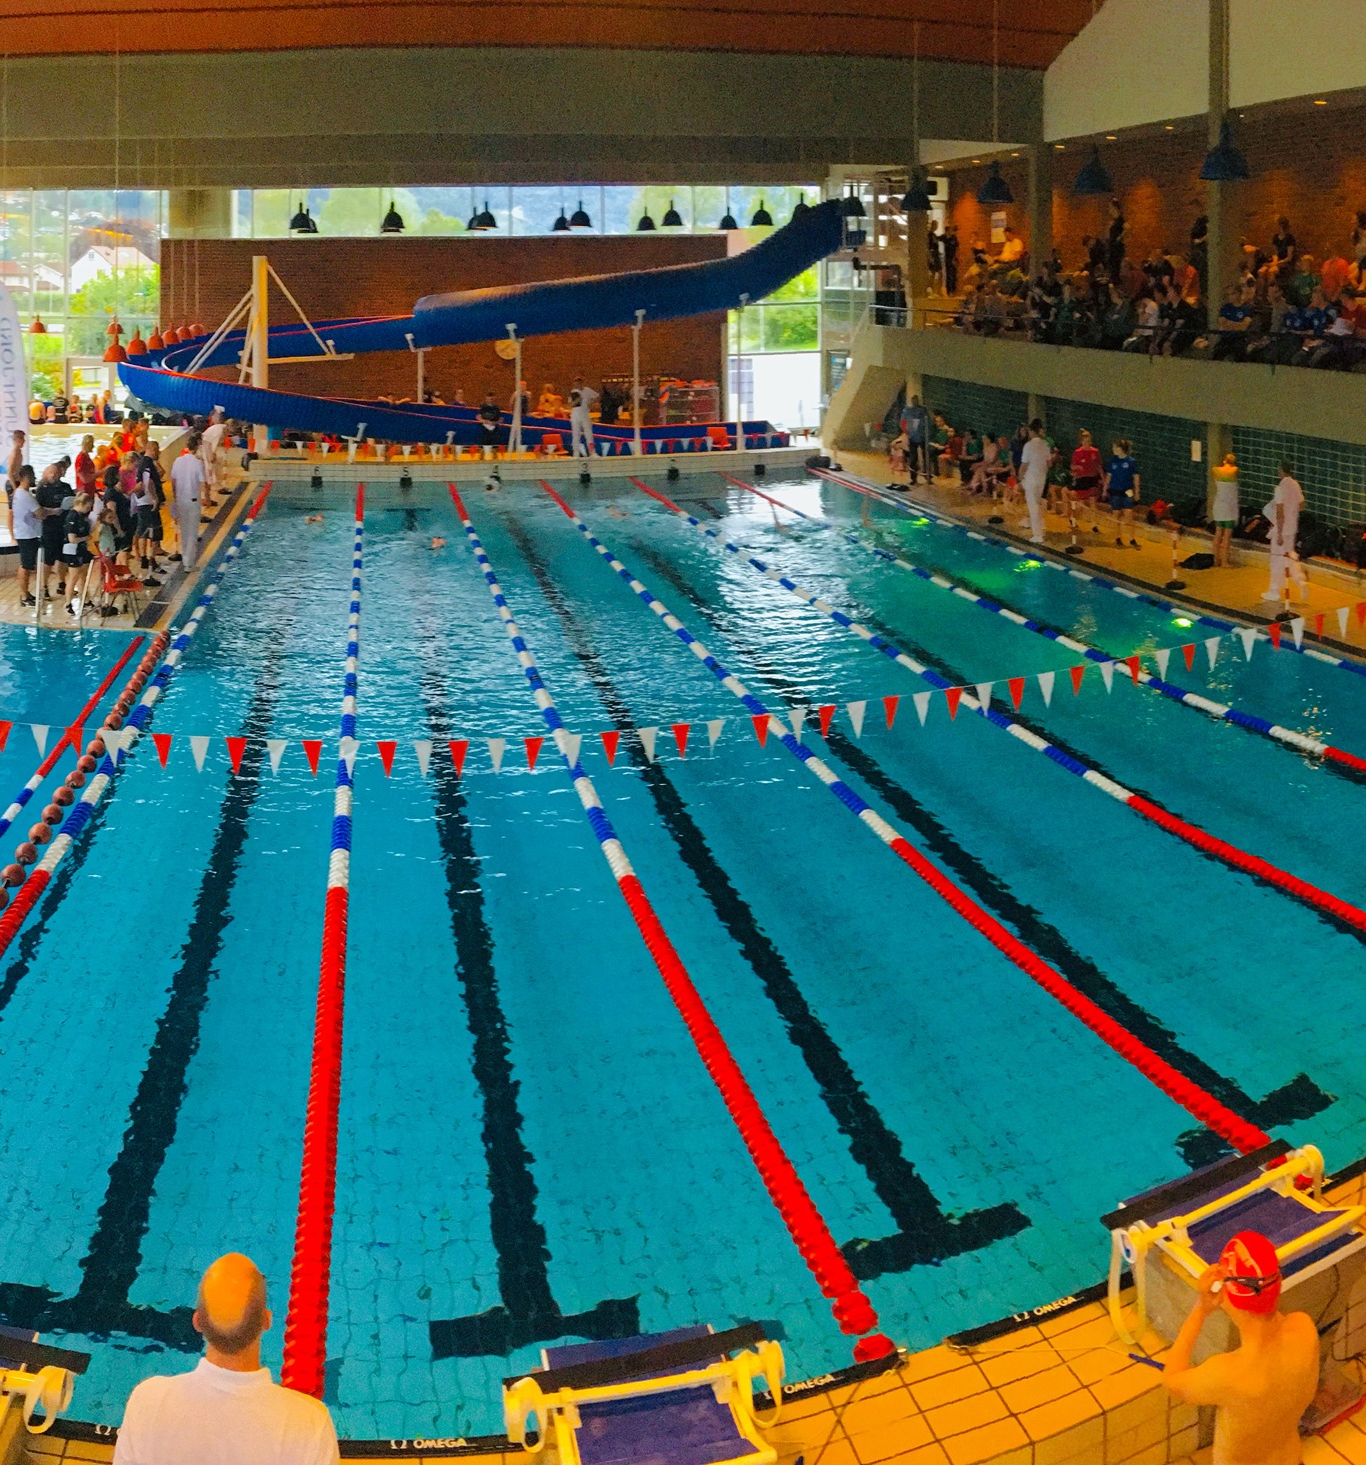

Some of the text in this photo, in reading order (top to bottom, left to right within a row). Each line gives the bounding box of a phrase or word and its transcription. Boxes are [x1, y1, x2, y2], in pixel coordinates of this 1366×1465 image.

[1033, 1295, 1077, 1316] OMEGA
[783, 1373, 835, 1394] OMEGA
[413, 1437, 468, 1449] OMEGA
